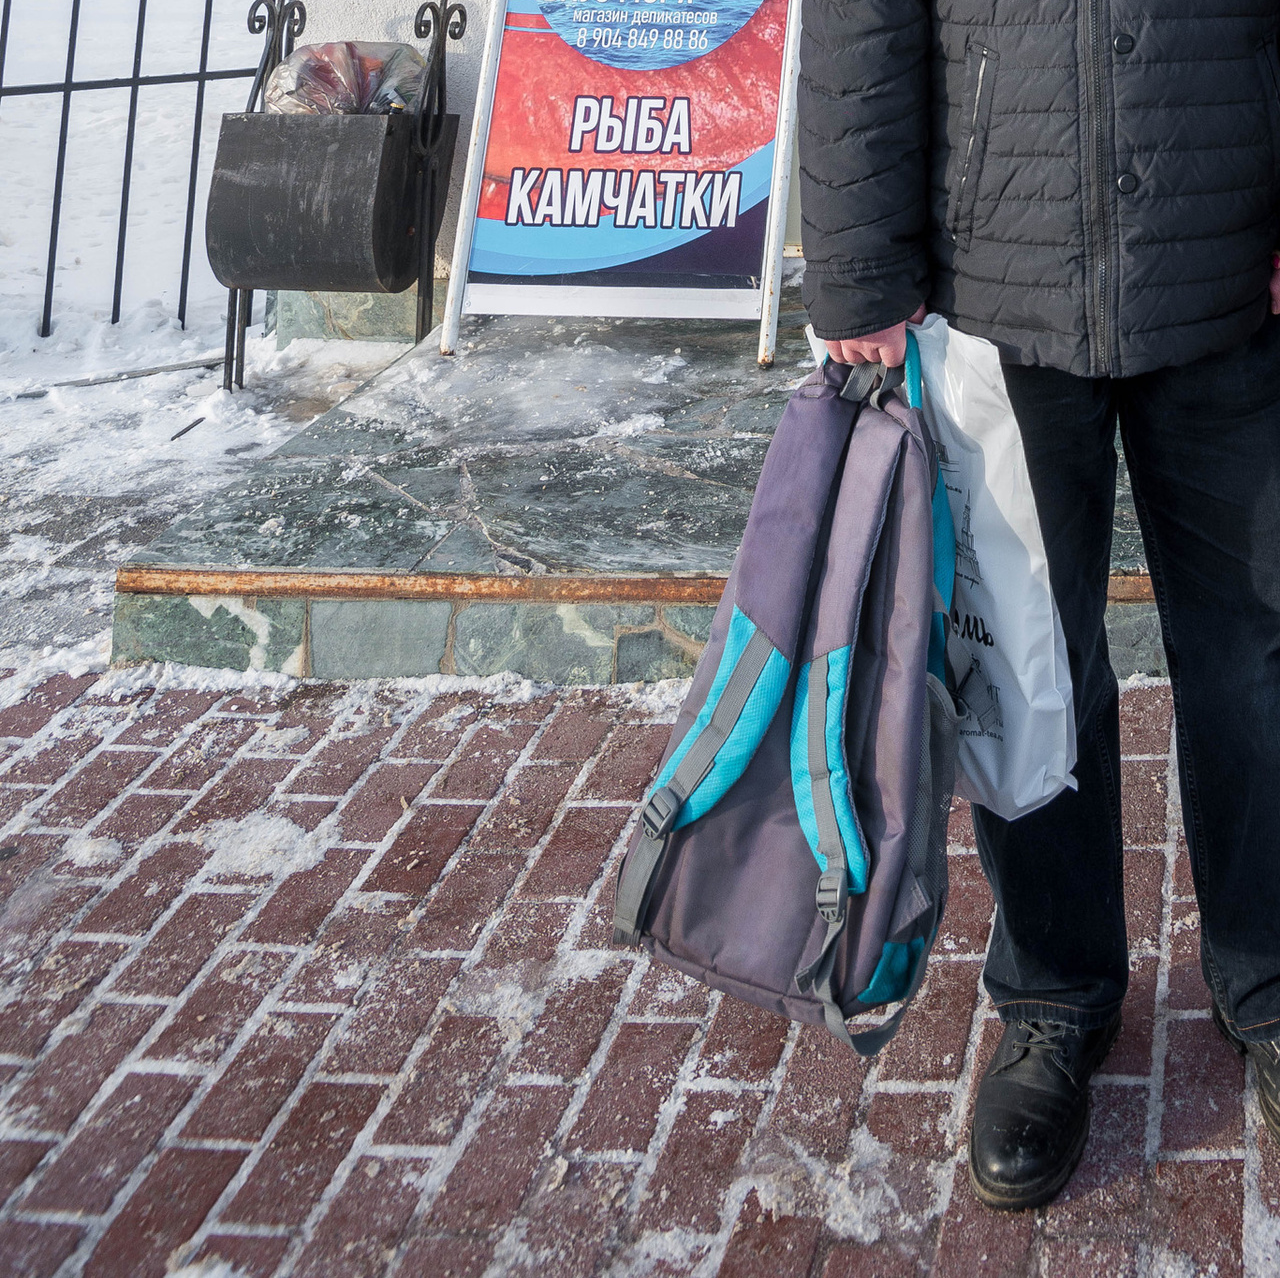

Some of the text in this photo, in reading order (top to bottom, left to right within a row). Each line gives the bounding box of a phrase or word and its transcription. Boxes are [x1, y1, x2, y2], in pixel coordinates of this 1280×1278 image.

[573, 9, 718, 26] магазин деликатесов
[576, 27, 709, 50] 8 904 849 88 86
[570, 96, 691, 154] РЫБА
[506, 168, 742, 229] КАМЧАТКИ
